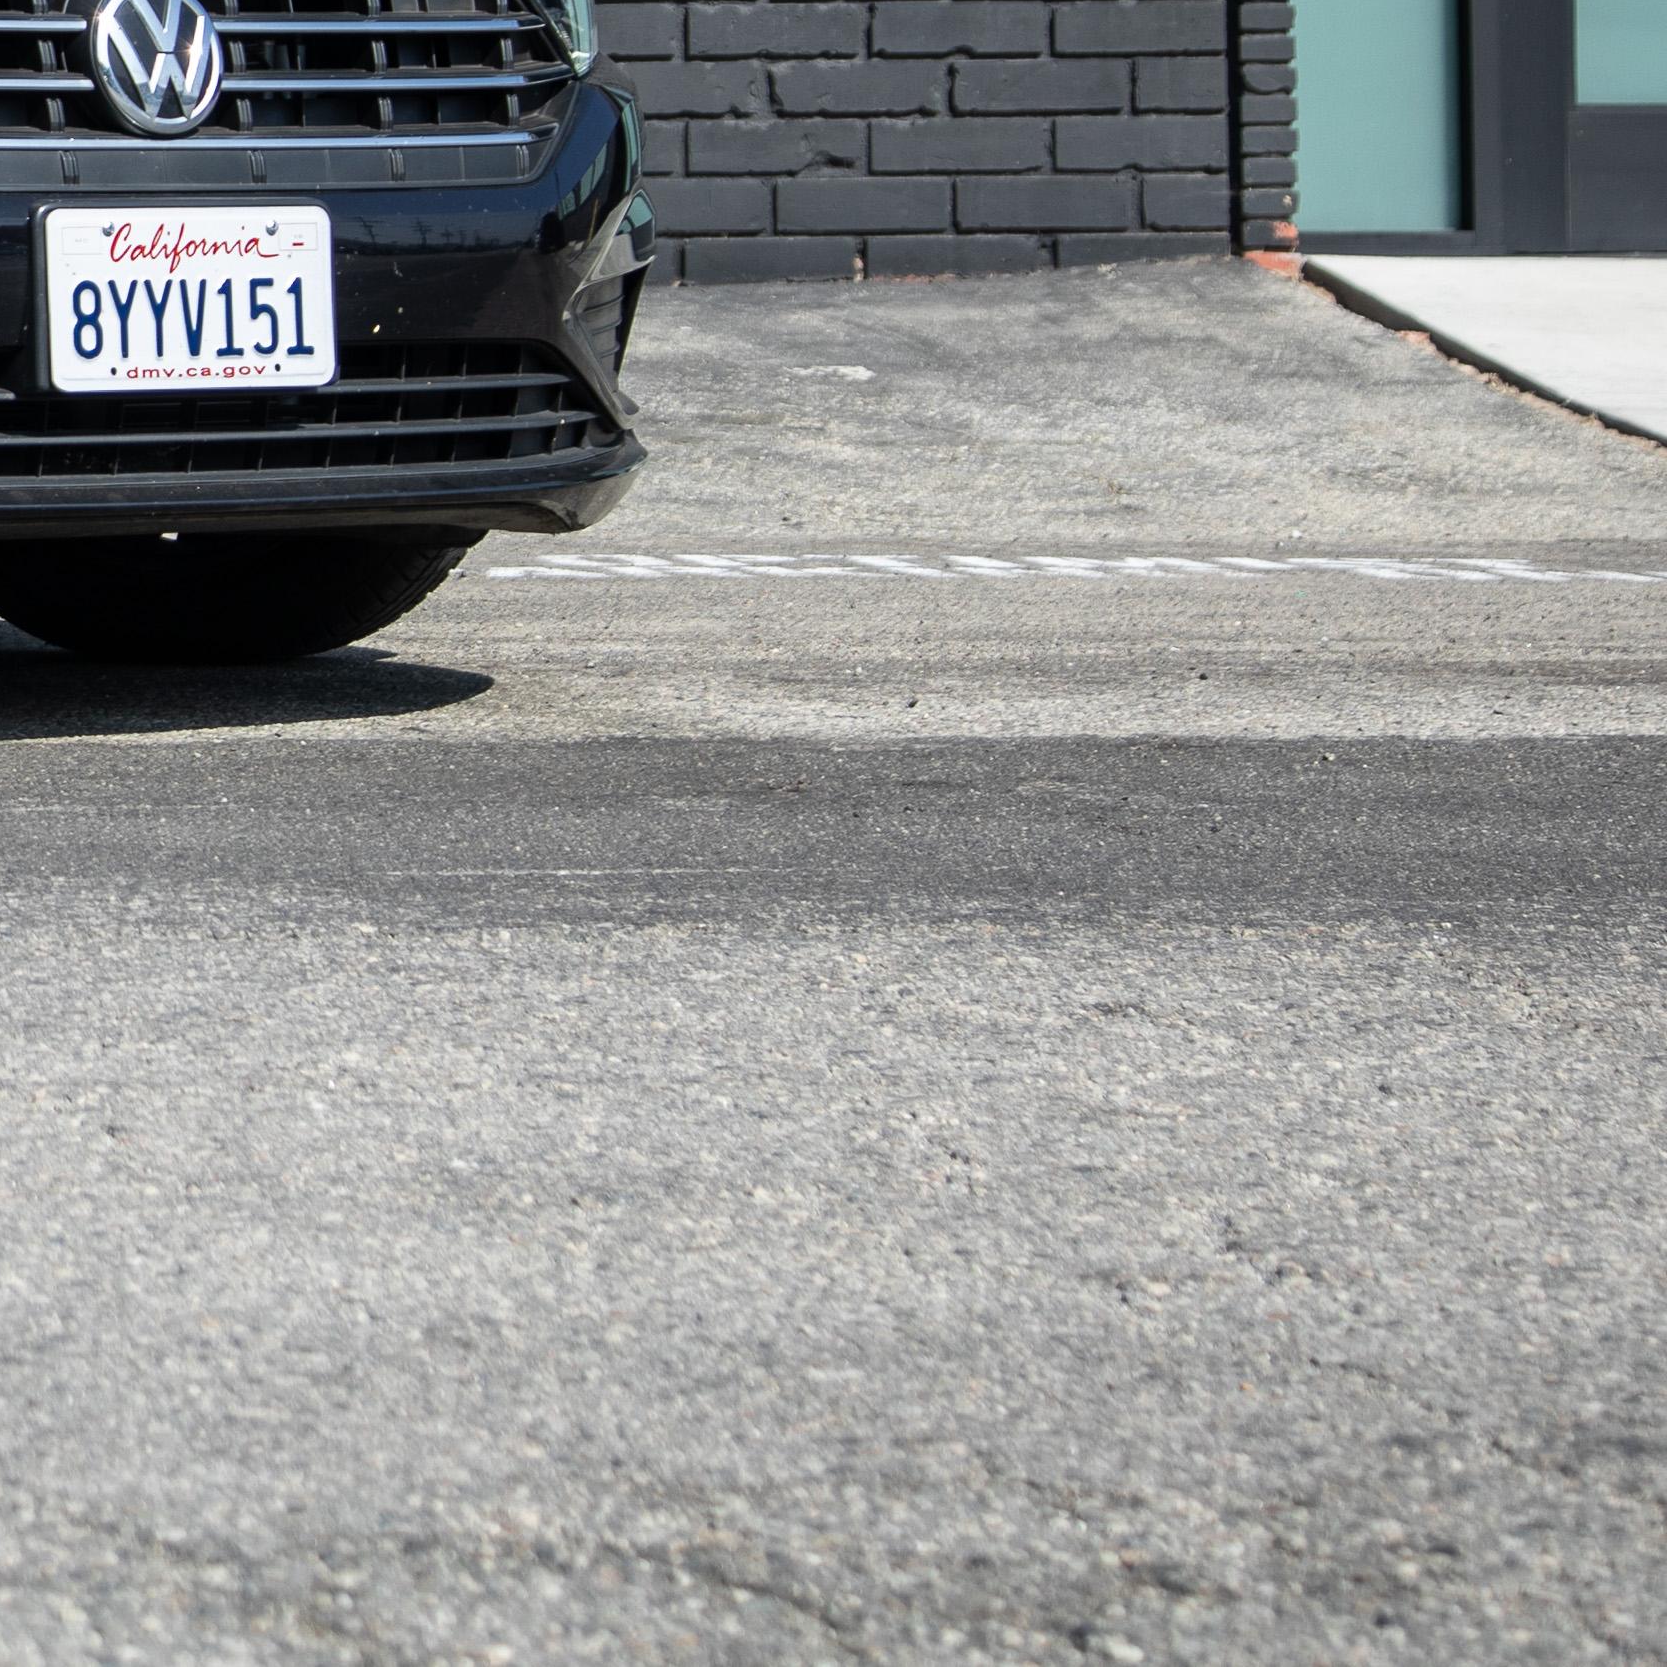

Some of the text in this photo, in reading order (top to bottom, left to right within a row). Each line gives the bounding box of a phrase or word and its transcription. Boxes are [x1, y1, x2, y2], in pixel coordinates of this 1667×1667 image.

[110, 222, 279, 274] California
[72, 276, 315, 360] 8YYV151
[126, 364, 266, 379] dmv.ca.gov
